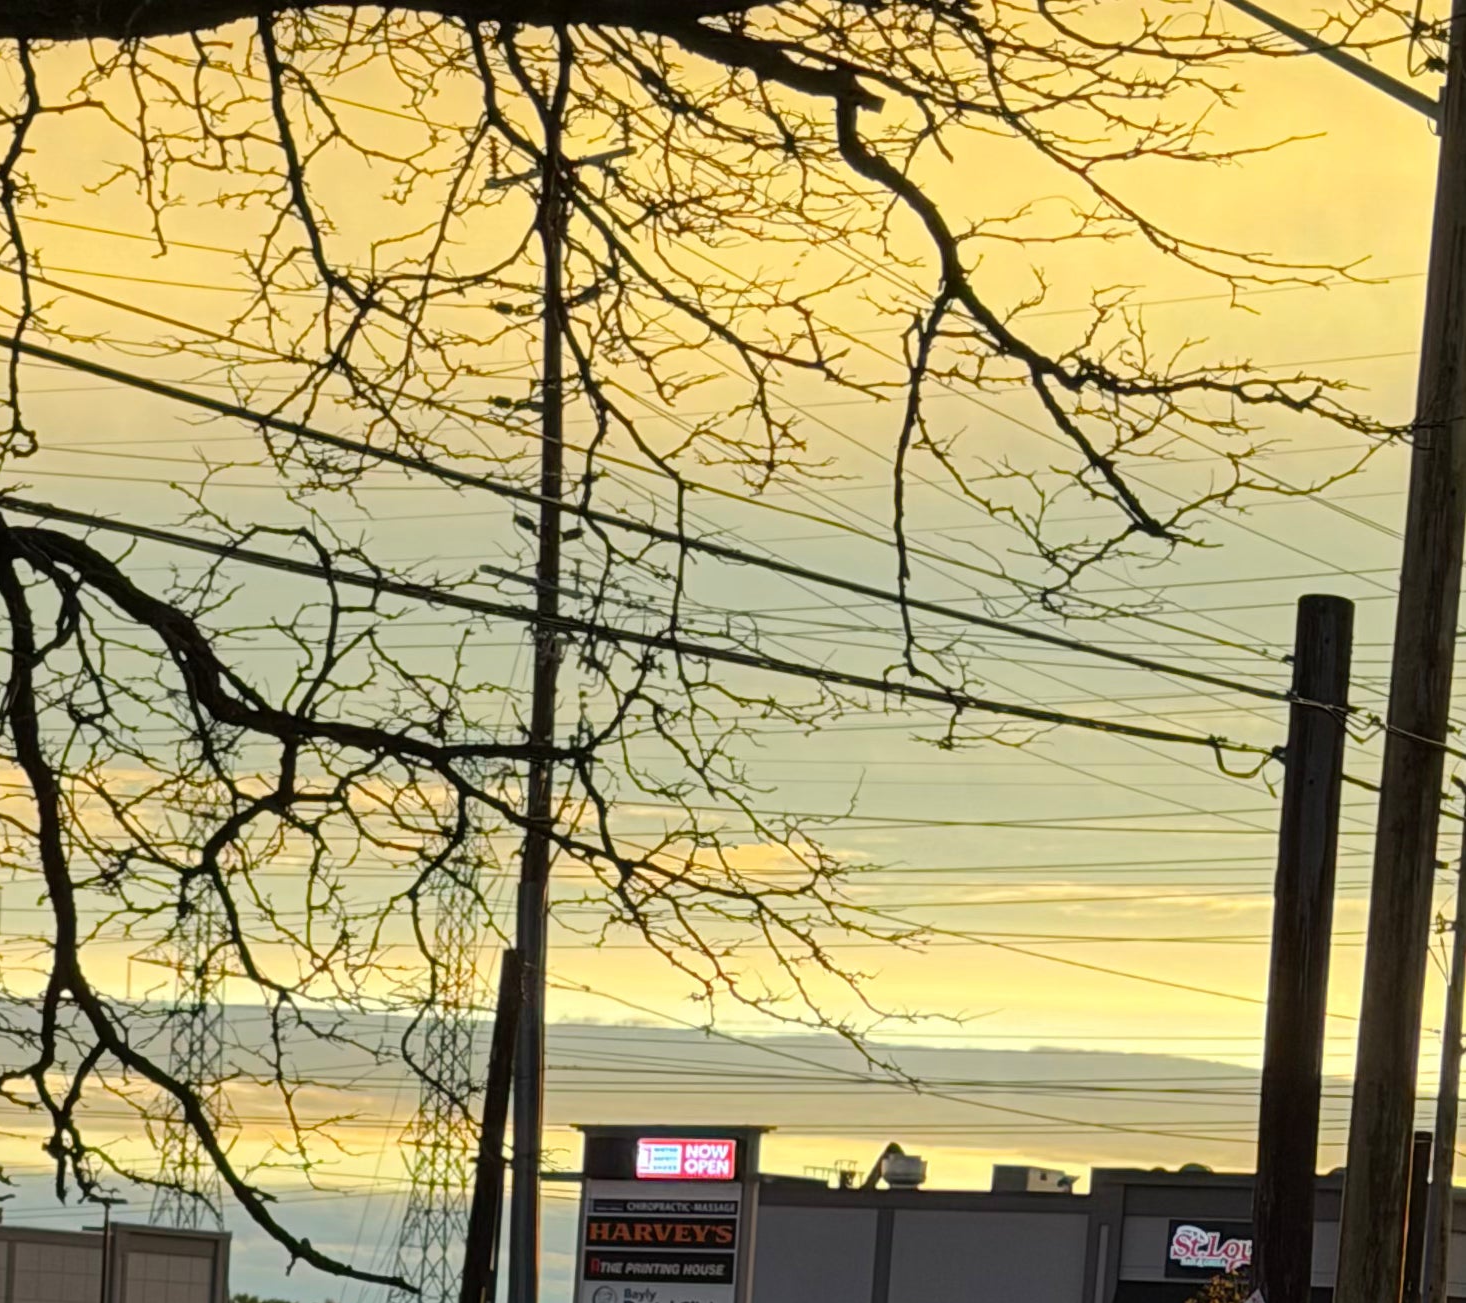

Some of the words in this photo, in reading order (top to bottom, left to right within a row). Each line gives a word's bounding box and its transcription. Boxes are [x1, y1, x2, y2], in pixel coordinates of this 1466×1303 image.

[685, 1144, 730, 1160] NOW
[684, 1159, 730, 1176] OPEN
[589, 1223, 734, 1244] HARVEY'S
[601, 1262, 623, 1274] THE
[625, 1263, 680, 1275] PRINTING
[683, 1264, 726, 1276] HOUSE
[624, 1288, 657, 1302] Bayly
